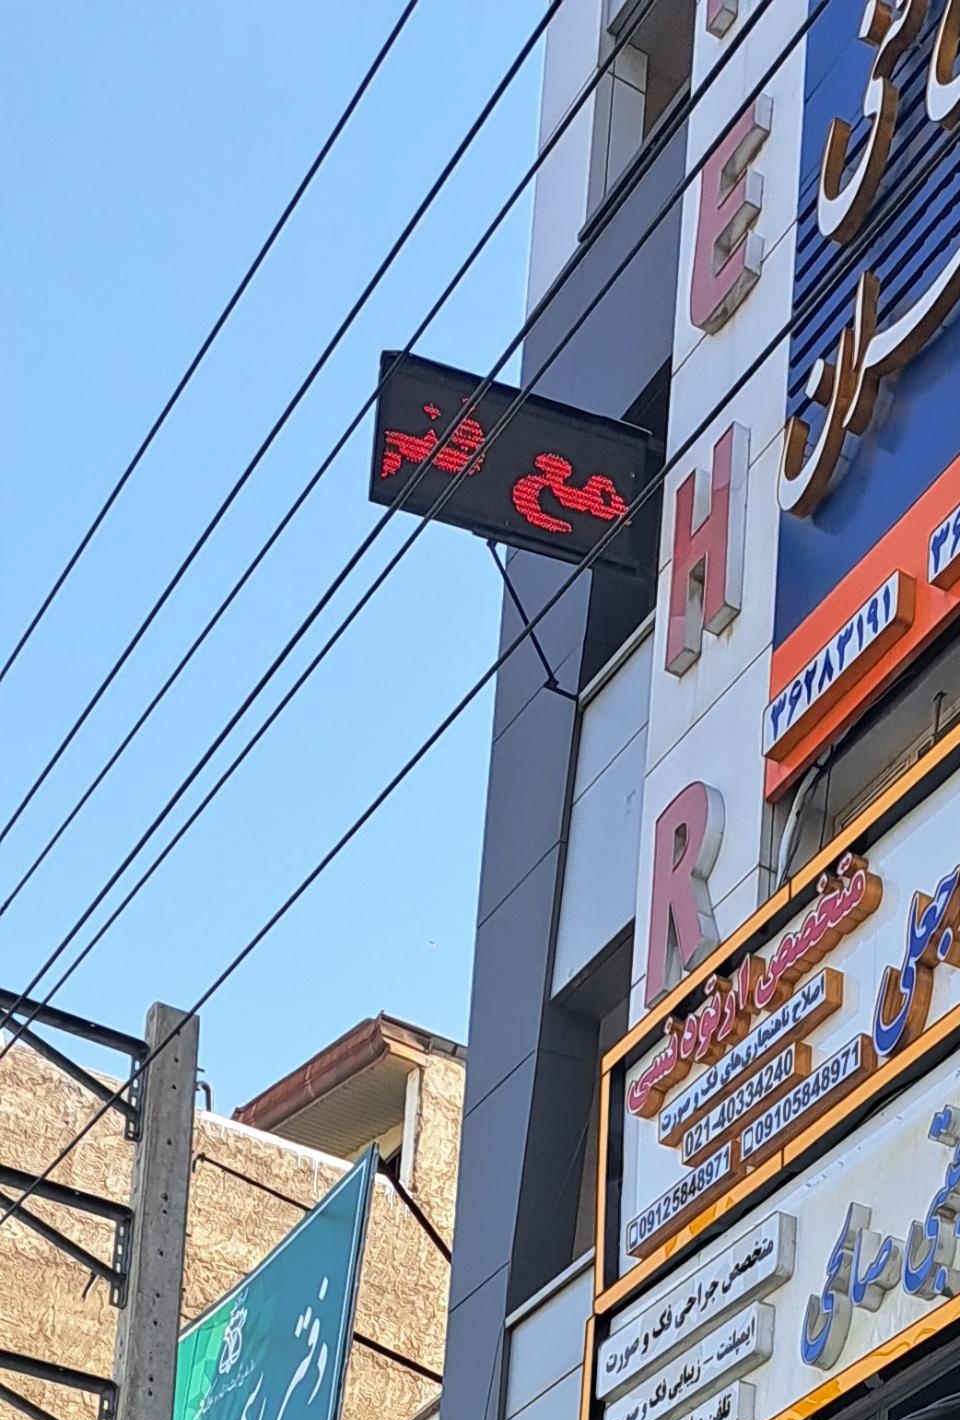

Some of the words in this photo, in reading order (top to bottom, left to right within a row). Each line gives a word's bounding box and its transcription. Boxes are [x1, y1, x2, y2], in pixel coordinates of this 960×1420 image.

[771, 584, 893, 740] ۳۶۲۸۳۱۹۱
[754, 851, 867, 1009] متخصص
[791, 971, 826, 1025] اصلاح
[627, 953, 752, 1114] ارتودنسی
[661, 1096, 693, 1133] صورت
[683, 1059, 794, 1159] 021-40334240
[754, 1042, 861, 1145] 09105848971
[638, 1147, 732, 1240] 09125848971
[721, 1237, 775, 1293] متخصص
[651, 1305, 673, 1340] فک
[674, 1279, 720, 1330] جراحی
[605, 1337, 641, 1374] صورت
[641, 1331, 650, 1352] و
[715, 1316, 756, 1362] ایمپلنت
[650, 1378, 668, 1410] فک
[667, 1357, 702, 1398] زیبایی
[640, 1400, 647, 1420] و
